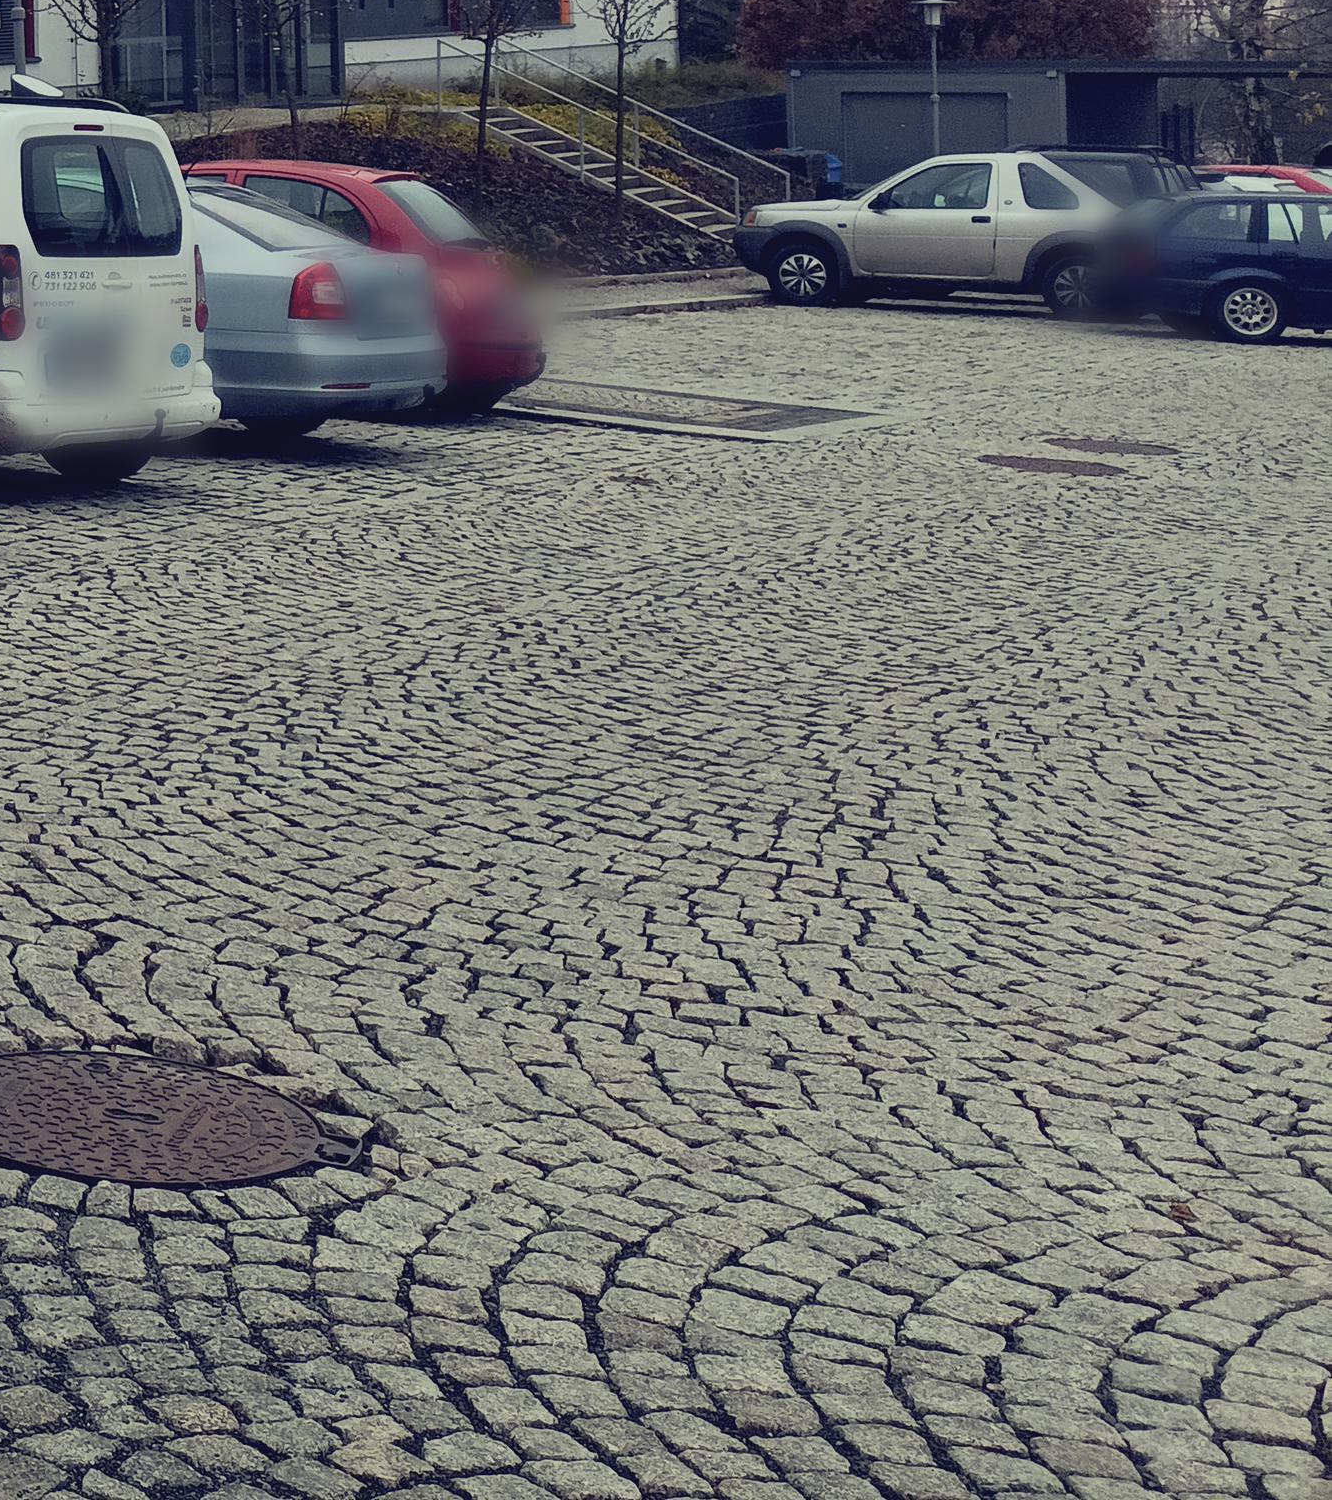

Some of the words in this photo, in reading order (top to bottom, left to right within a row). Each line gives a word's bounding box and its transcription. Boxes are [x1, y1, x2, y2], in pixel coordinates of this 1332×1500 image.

[62, 271, 78, 280] 321
[44, 282, 60, 291] 731
[63, 282, 78, 291] 122
[79, 282, 97, 291] 906
